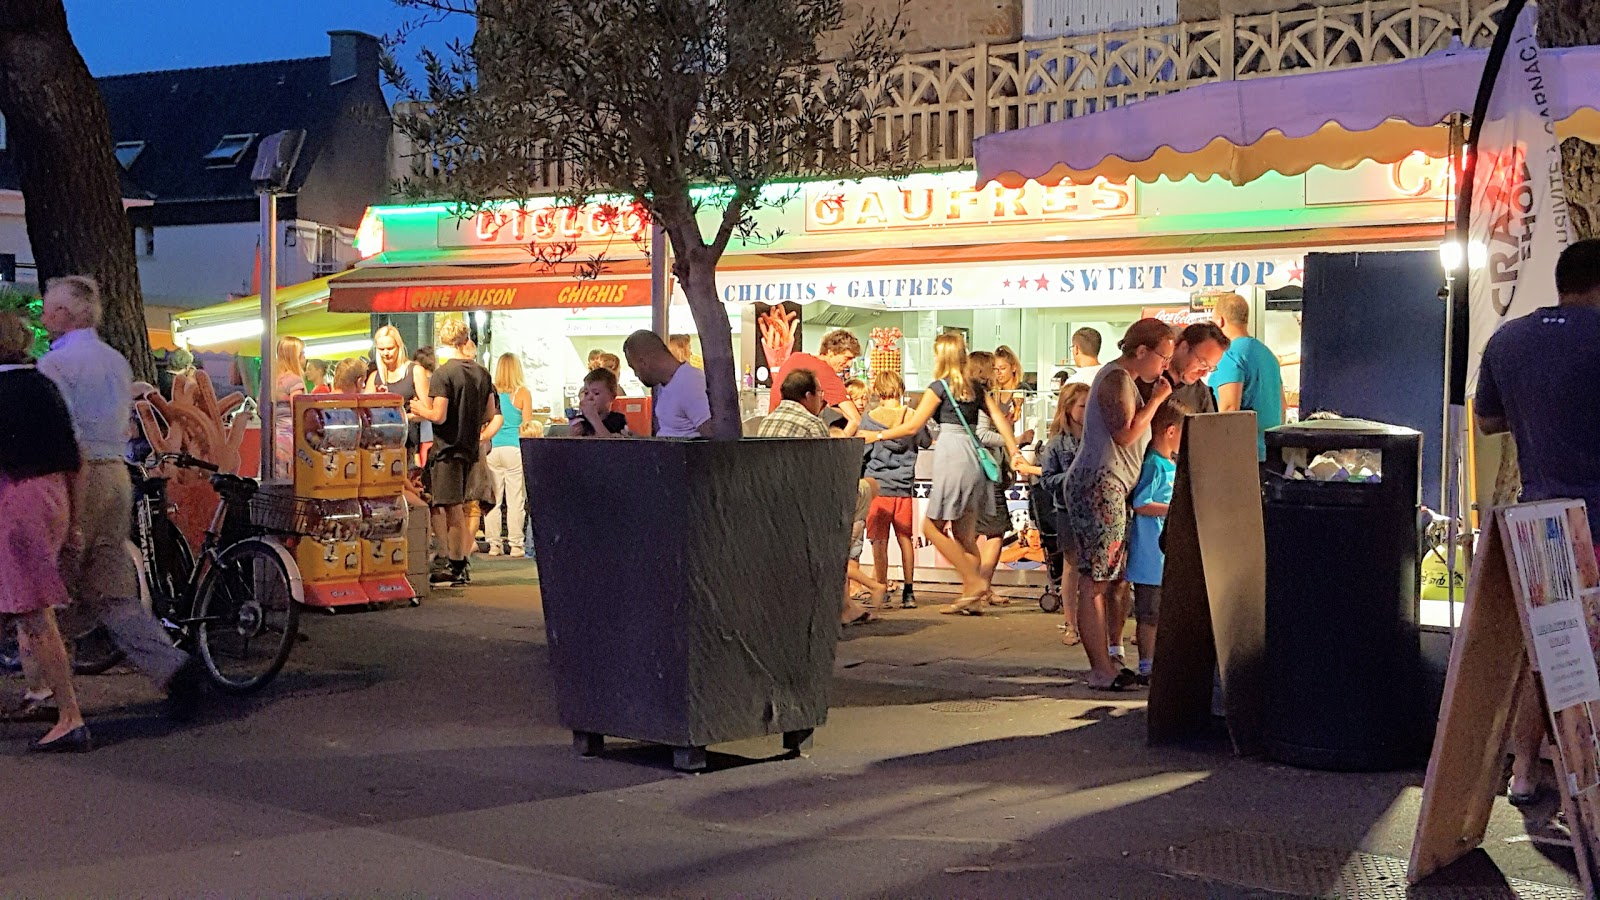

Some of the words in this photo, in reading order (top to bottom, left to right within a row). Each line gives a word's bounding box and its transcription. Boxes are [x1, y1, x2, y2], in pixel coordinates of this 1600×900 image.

[813, 176, 1130, 226] GAUFRES
[724, 282, 817, 302] CHICHIS
[847, 277, 953, 298] GAUFRES
[1060, 265, 1168, 293] SWEET
[1182, 261, 1276, 287] SHOP
[453, 288, 517, 306] MAISON
[557, 284, 629, 304] CHICHIS
